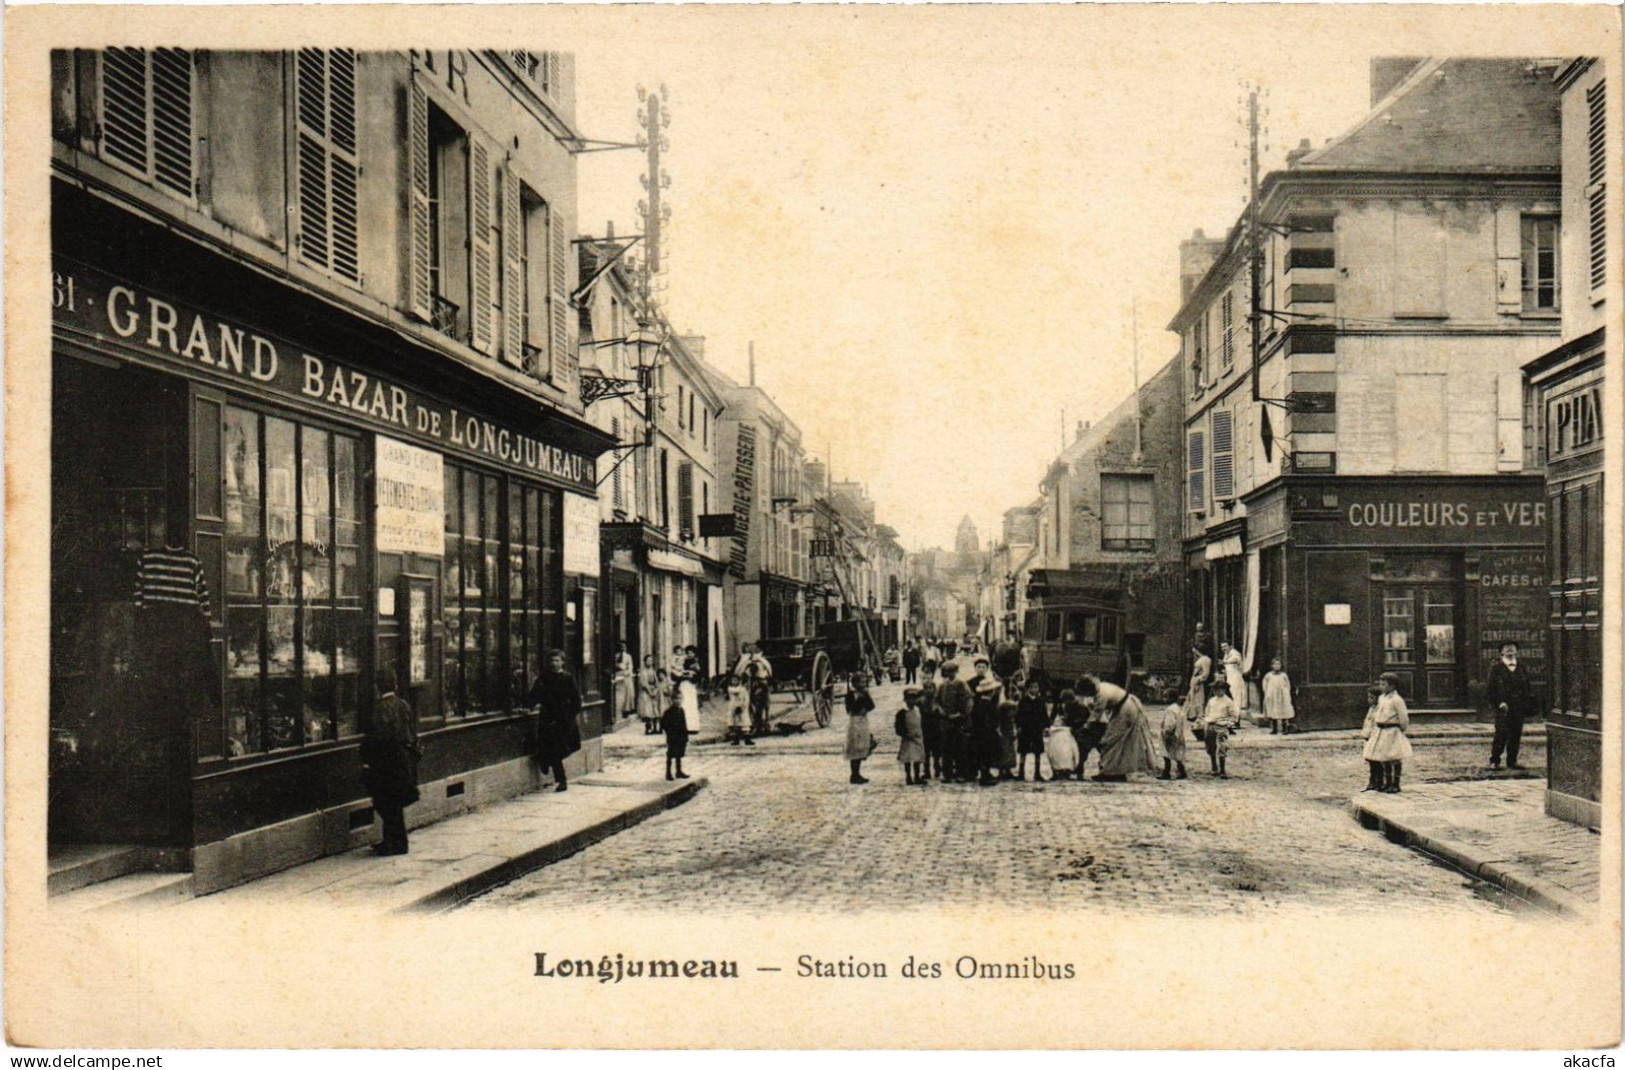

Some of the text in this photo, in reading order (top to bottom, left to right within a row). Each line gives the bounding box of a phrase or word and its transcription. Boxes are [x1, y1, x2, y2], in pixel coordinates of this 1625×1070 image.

[107, 285, 279, 382] GRAND
[302, 354, 408, 427] BAZAR
[417, 405, 441, 438] DE
[450, 409, 582, 482] LONGJUMEAU
[1554, 388, 1604, 453] PHA
[1349, 503, 1469, 527] COULEURS
[1476, 511, 1499, 526] ET
